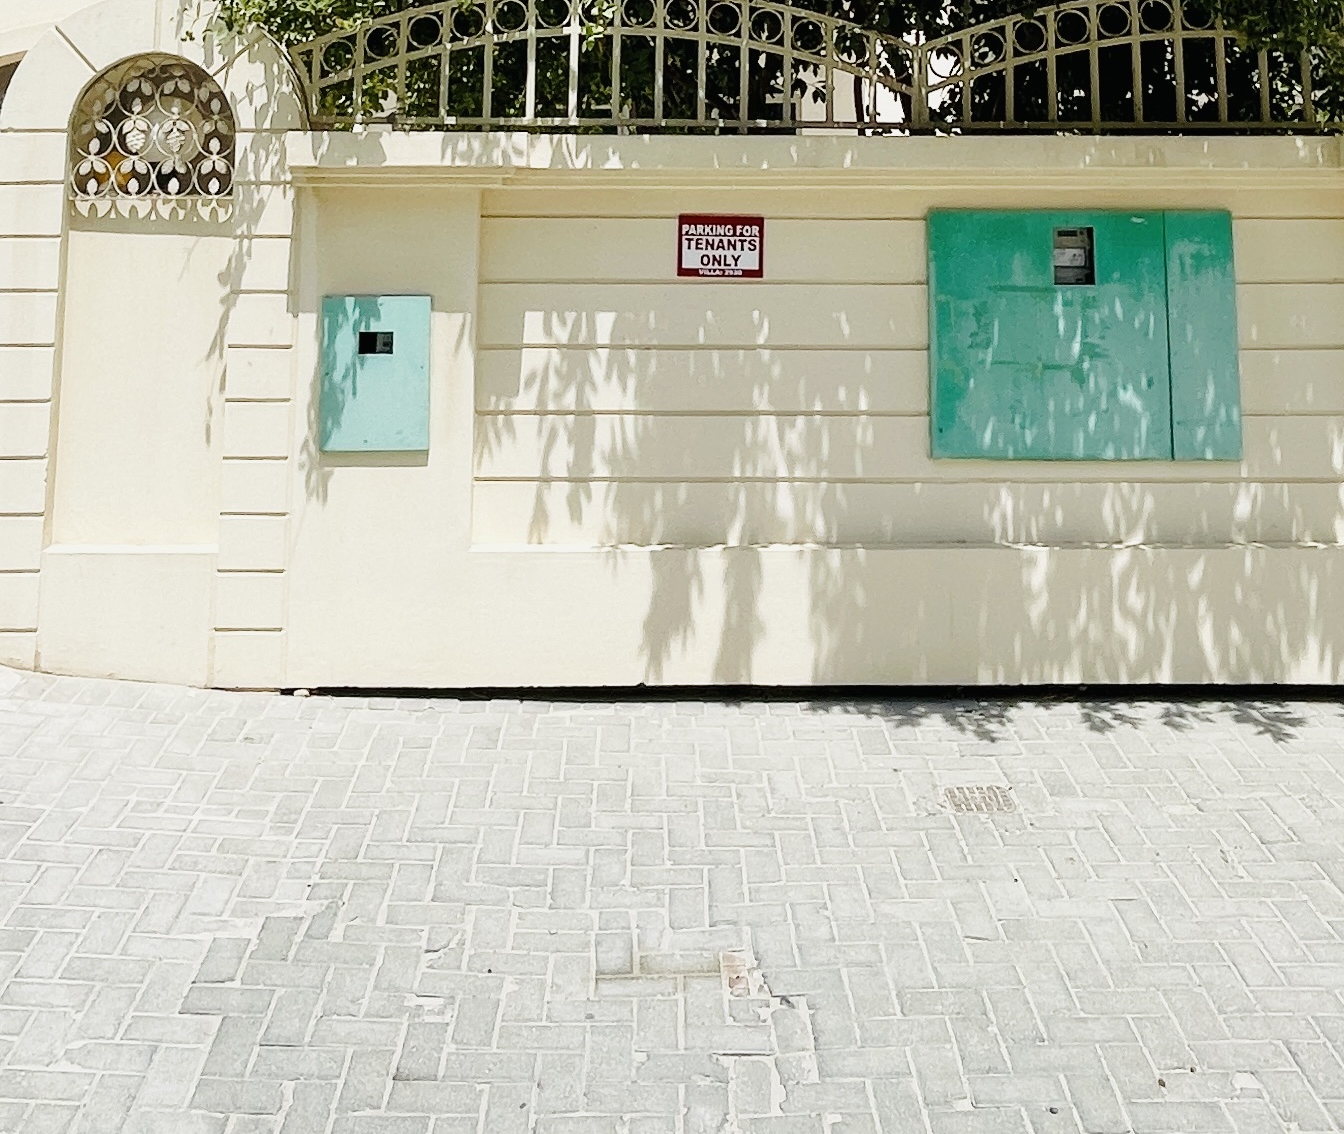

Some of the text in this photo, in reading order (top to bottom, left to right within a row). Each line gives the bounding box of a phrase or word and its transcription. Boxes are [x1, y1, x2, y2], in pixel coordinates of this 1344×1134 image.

[681, 224, 760, 237] PARKING FOR
[685, 237, 757, 252] TENANTS
[700, 254, 742, 267] ONLY
